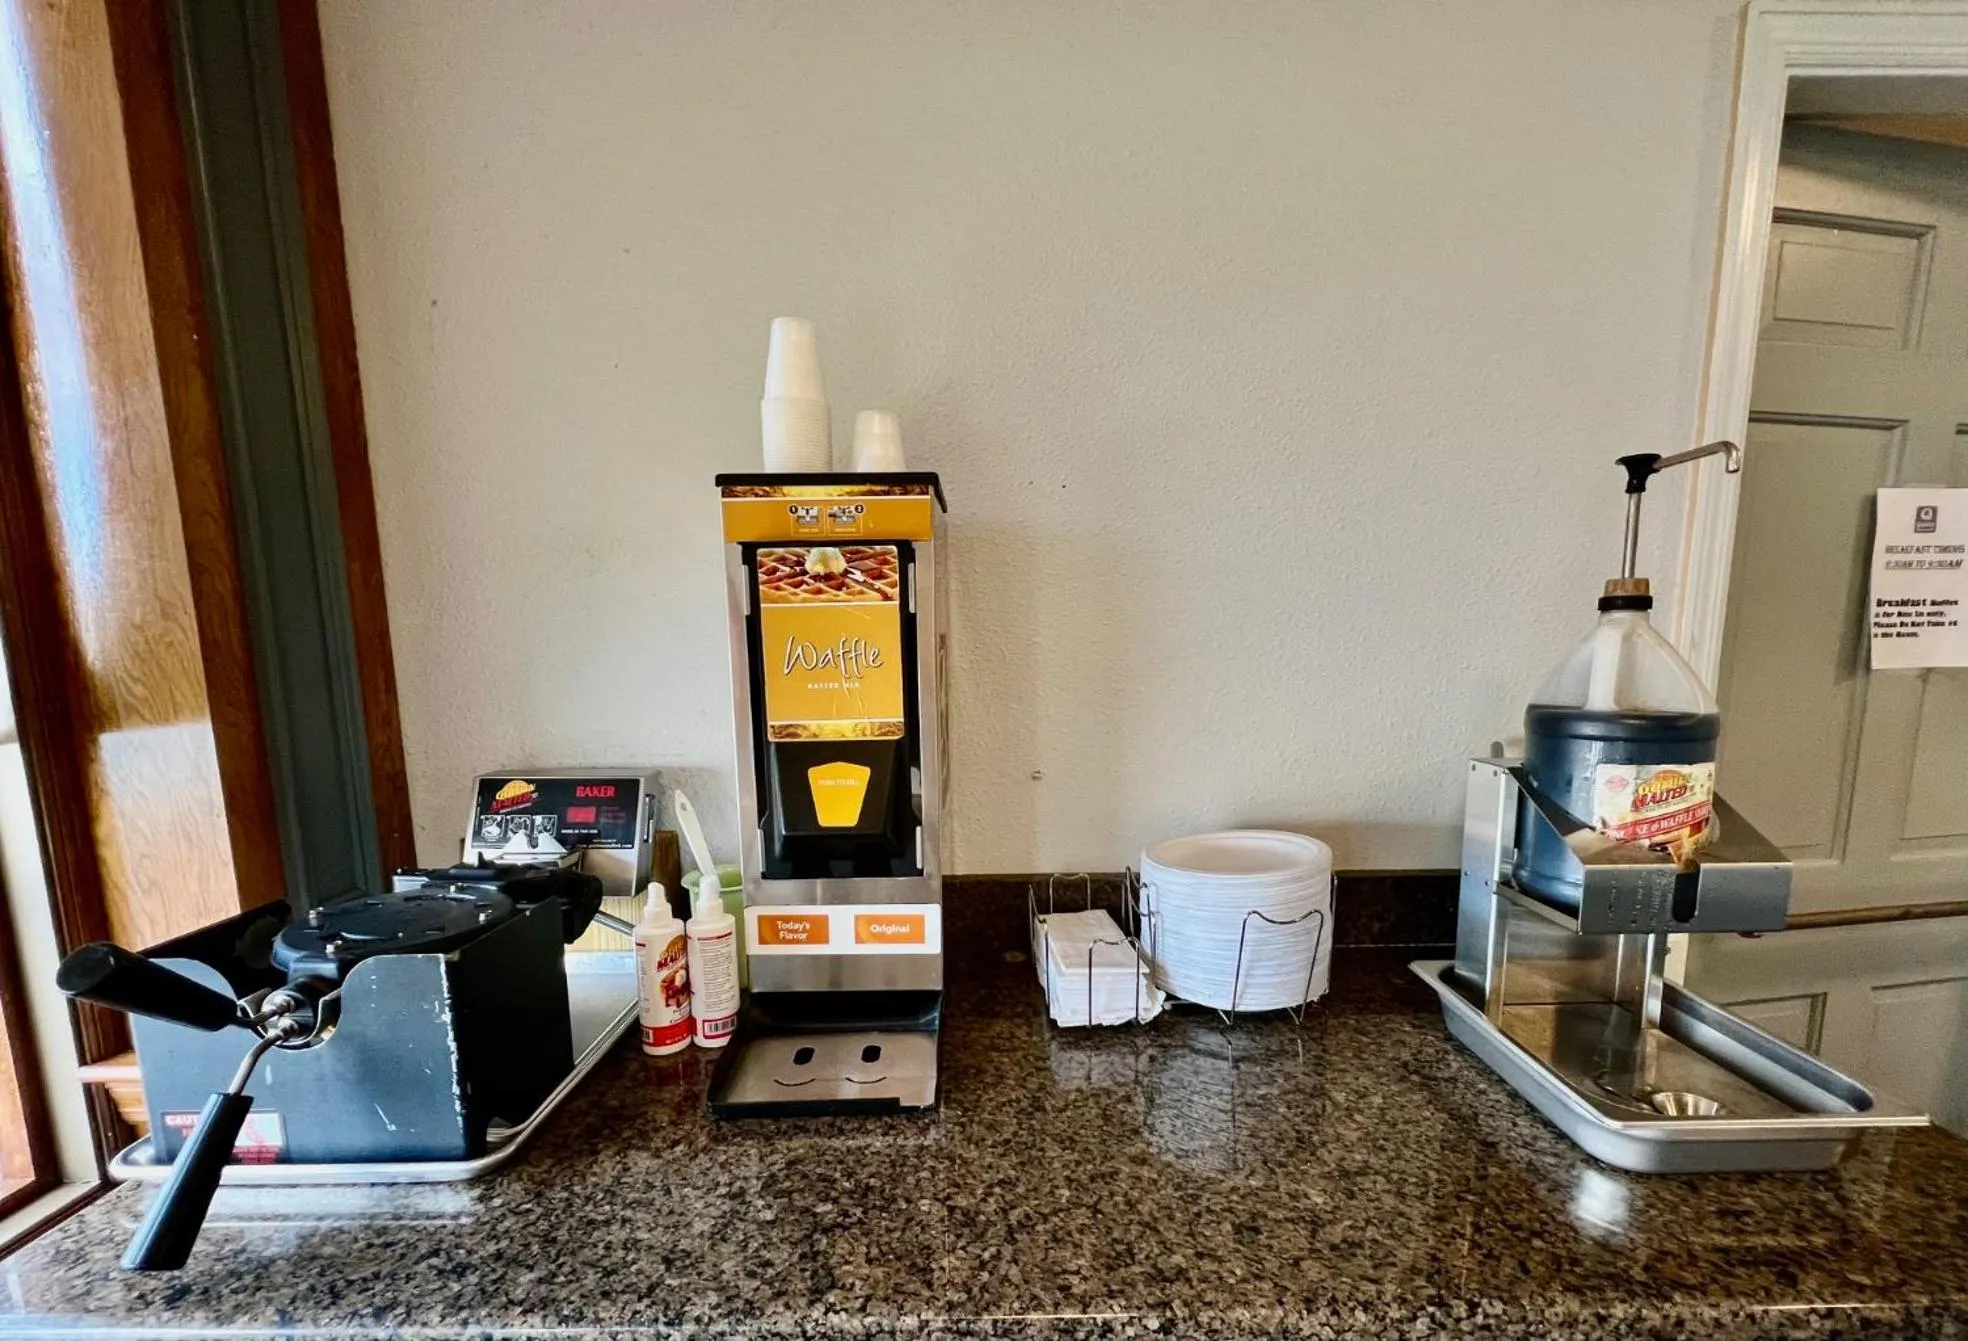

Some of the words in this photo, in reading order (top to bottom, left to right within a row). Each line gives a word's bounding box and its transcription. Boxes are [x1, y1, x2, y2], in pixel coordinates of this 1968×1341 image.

[1876, 598, 1927, 607] Breakfast
[784, 635, 885, 679] Waffle
[807, 682, 840, 690] BATTER
[576, 786, 615, 798] BAKER
[1660, 812, 1692, 829] WAFFLE
[776, 920, 811, 931] Today's
[869, 923, 911, 934] Original
[779, 930, 809, 940] Flavor
[164, 1115, 200, 1126] CAUT
